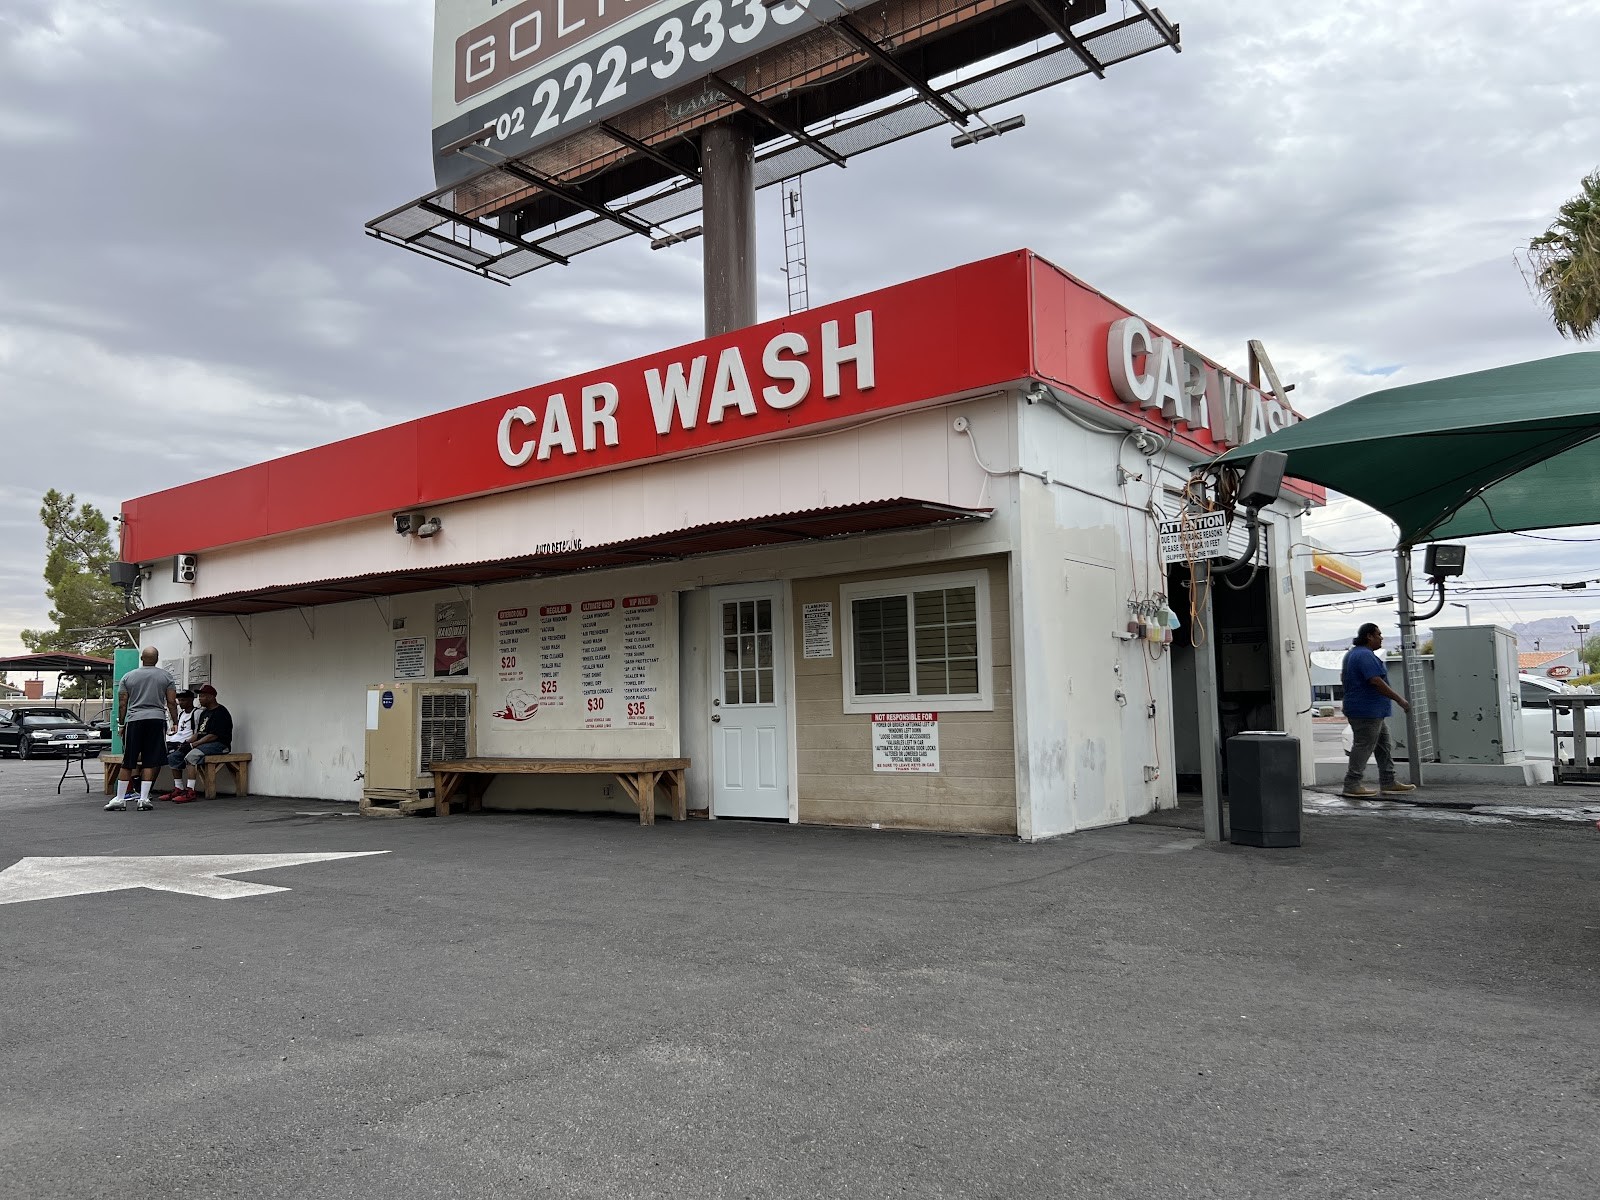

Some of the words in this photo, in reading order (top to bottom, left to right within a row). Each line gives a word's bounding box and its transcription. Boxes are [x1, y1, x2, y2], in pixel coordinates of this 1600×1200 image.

[1107, 316, 1210, 430] CAR
[497, 382, 619, 467] CAR
[644, 310, 875, 434] WASH
[1161, 514, 1223, 534] ATTENTION
[1161, 536, 1170, 544] DUE
[1171, 535, 1177, 543] TO
[1203, 529, 1222, 539] REASONS
[536, 541, 551, 553] AUTO
[1163, 544, 1179, 553] PLEASE
[1210, 539, 1220, 547] FEET
[1197, 550, 1206, 558] THE
[546, 605, 567, 615] REGULAR
[501, 656, 516, 669] $20
[541, 681, 557, 694] $25
[588, 697, 604, 712] $30
[627, 702, 645, 716] $35
[875, 713, 885, 721] NOT
[886, 713, 921, 721] RESPONSIBLE
